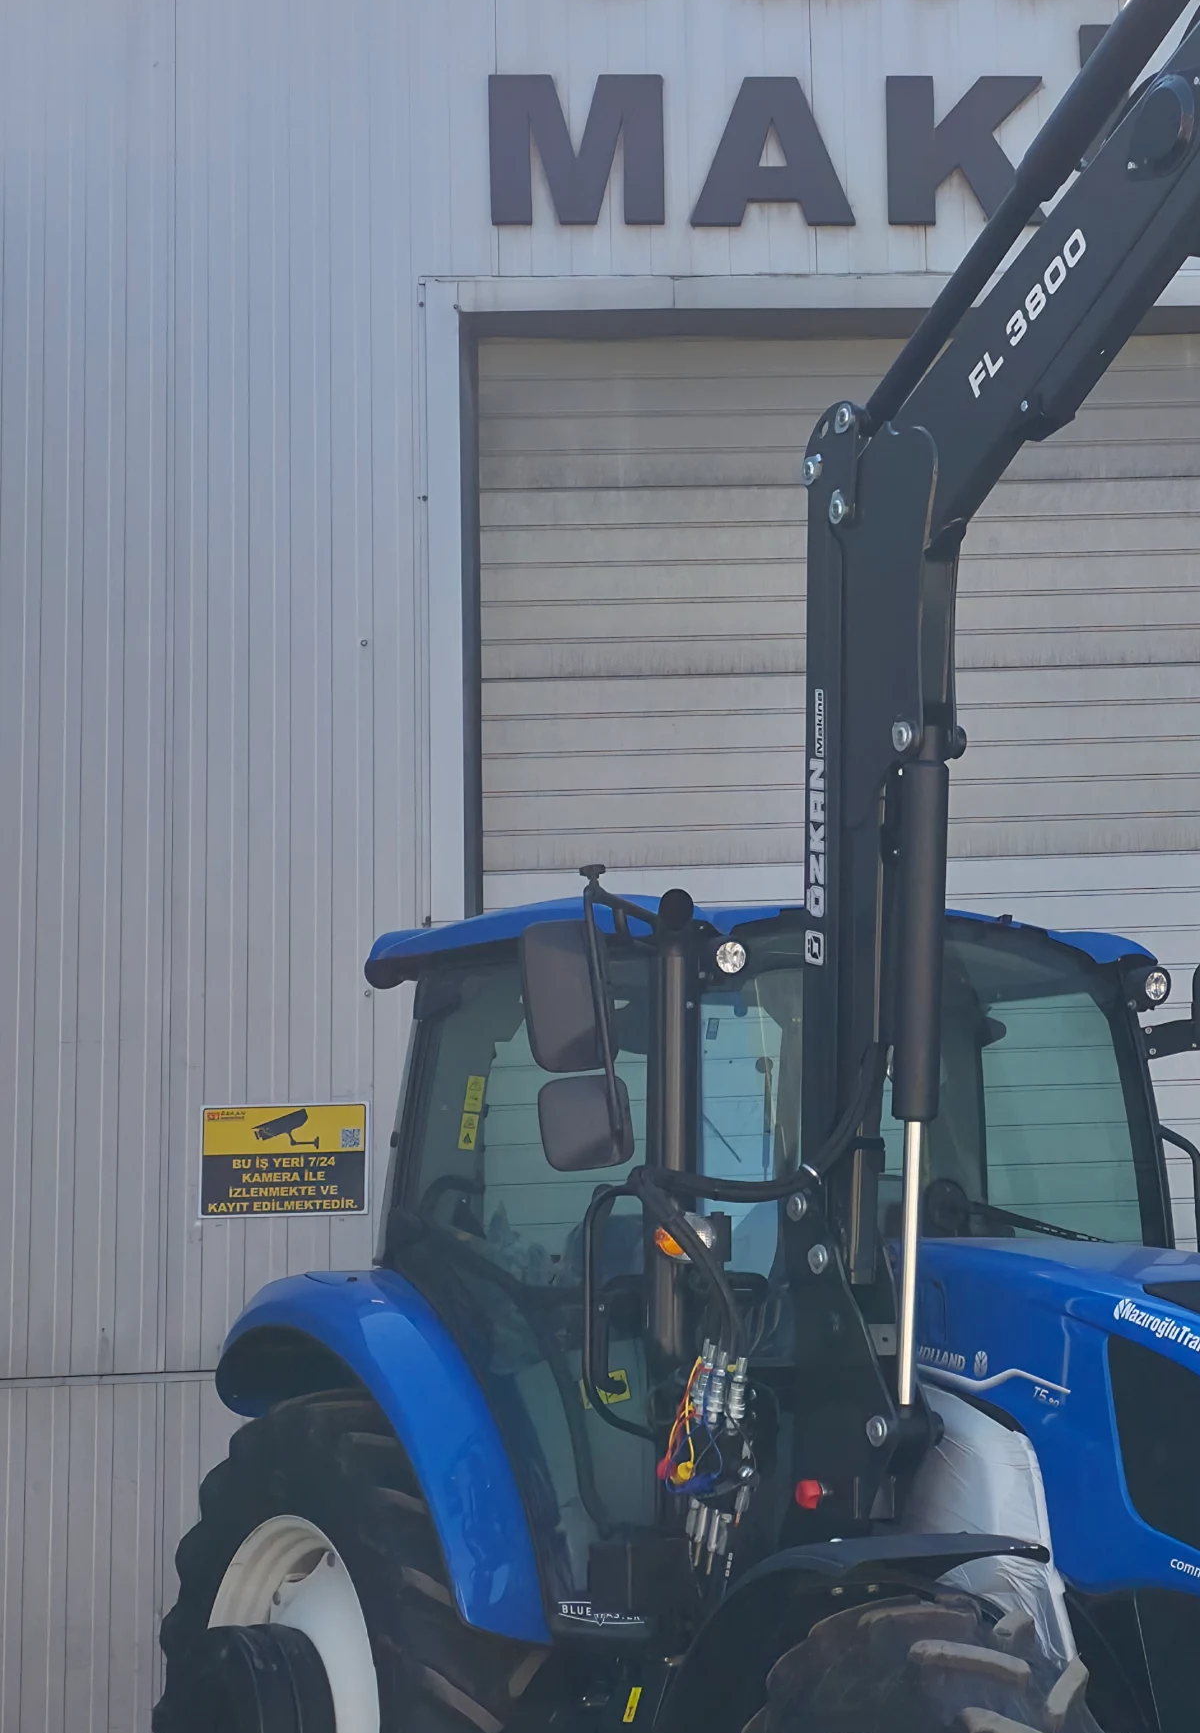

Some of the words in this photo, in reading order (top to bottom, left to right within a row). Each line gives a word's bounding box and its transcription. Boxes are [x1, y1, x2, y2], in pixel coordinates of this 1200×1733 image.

[968, 352, 1004, 398] FL
[1006, 228, 1086, 346] 3800
[232, 1158, 251, 1169] BU
[256, 1156, 269, 1170] İŞ
[273, 1156, 304, 1168] YERİ
[309, 1156, 336, 1167] 7/24
[242, 1172, 300, 1183] KAMERA
[304, 1170, 325, 1181] İLE
[229, 1185, 316, 1198] İZLENMEKTE
[321, 1186, 338, 1195] VE
[208, 1202, 249, 1213] KAYIT
[253, 1198, 358, 1211] EDİLMEKTEDİR.
[562, 1604, 592, 1616] BLUE
